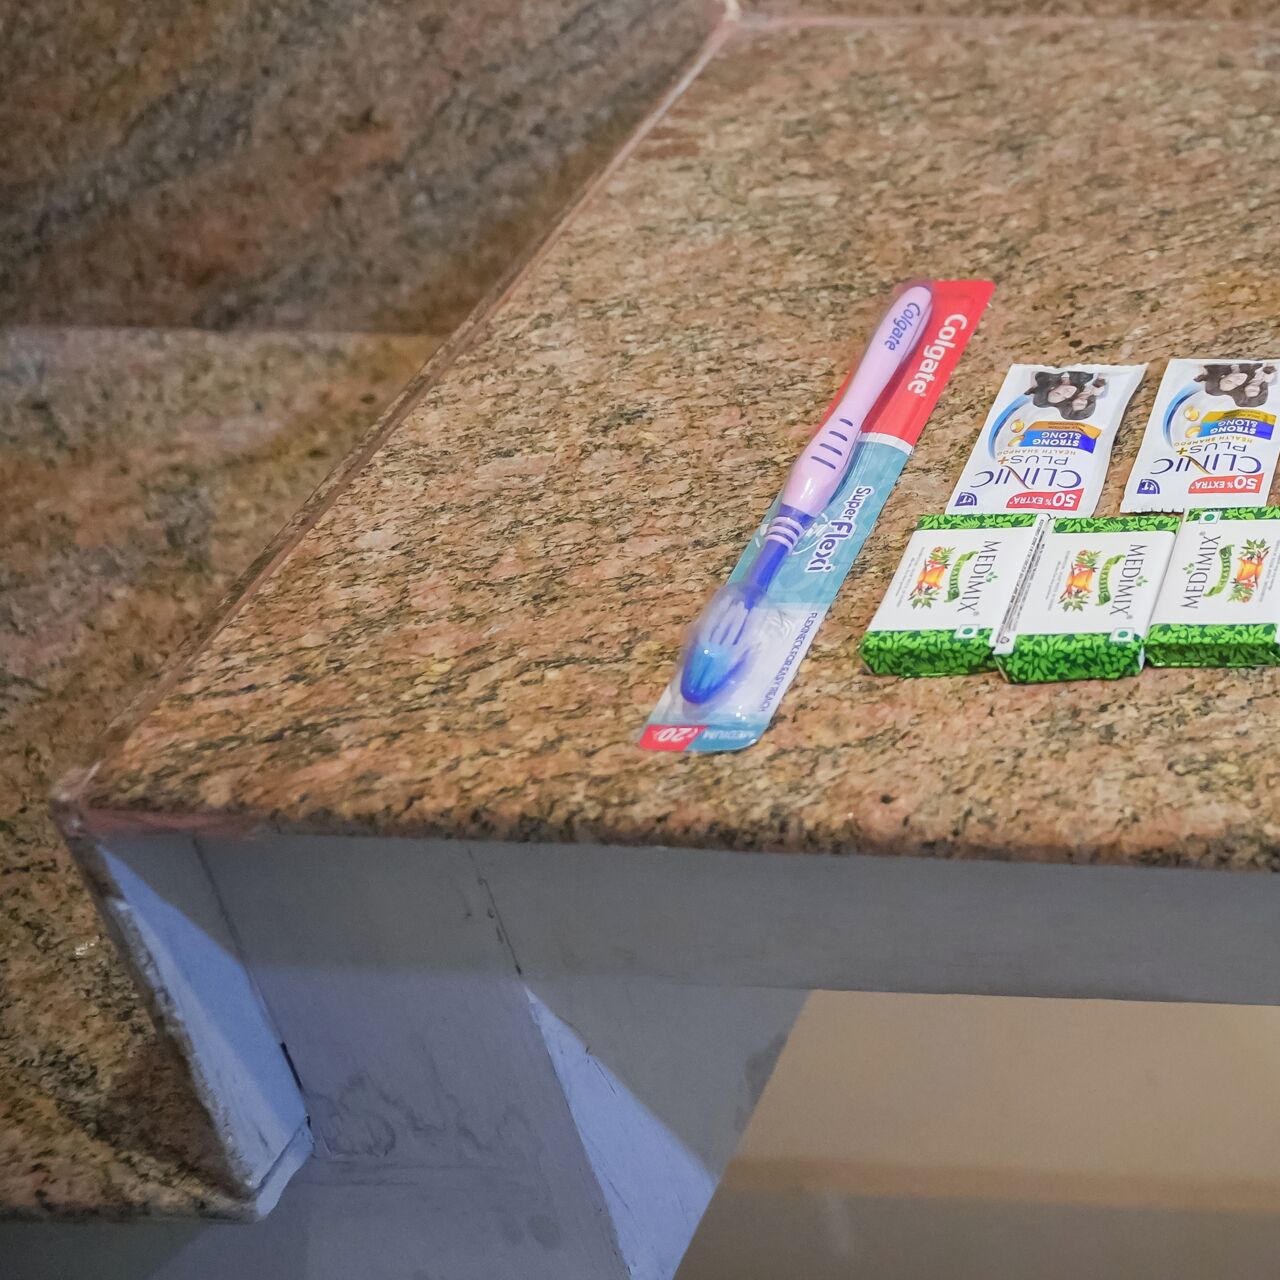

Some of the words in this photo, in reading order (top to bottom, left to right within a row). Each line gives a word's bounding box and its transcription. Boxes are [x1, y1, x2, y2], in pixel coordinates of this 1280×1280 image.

[885, 302, 921, 351] Colgate
[907, 314, 968, 395] Colgate
[1210, 426, 1257, 434] STRONG
[1219, 435, 1253, 443] HEALTH
[997, 448, 1039, 456] SHAMPOO
[1032, 439, 1080, 447] STRONG
[1042, 448, 1077, 456] HEALTH
[1174, 438, 1215, 447] SHAMPOO
[1150, 454, 1262, 475] CLINIC
[970, 465, 1082, 489] CLINIC
[1227, 476, 1258, 489] 50%
[844, 487, 872, 521] Super
[1046, 492, 1077, 507] 50%
[808, 521, 853, 571] Flexi
[957, 540, 1002, 613] MEDIMIX
[1110, 544, 1149, 616] MEDIMIX
[1180, 535, 1222, 609] MEDIMIX
[772, 664, 788, 686] EASY
